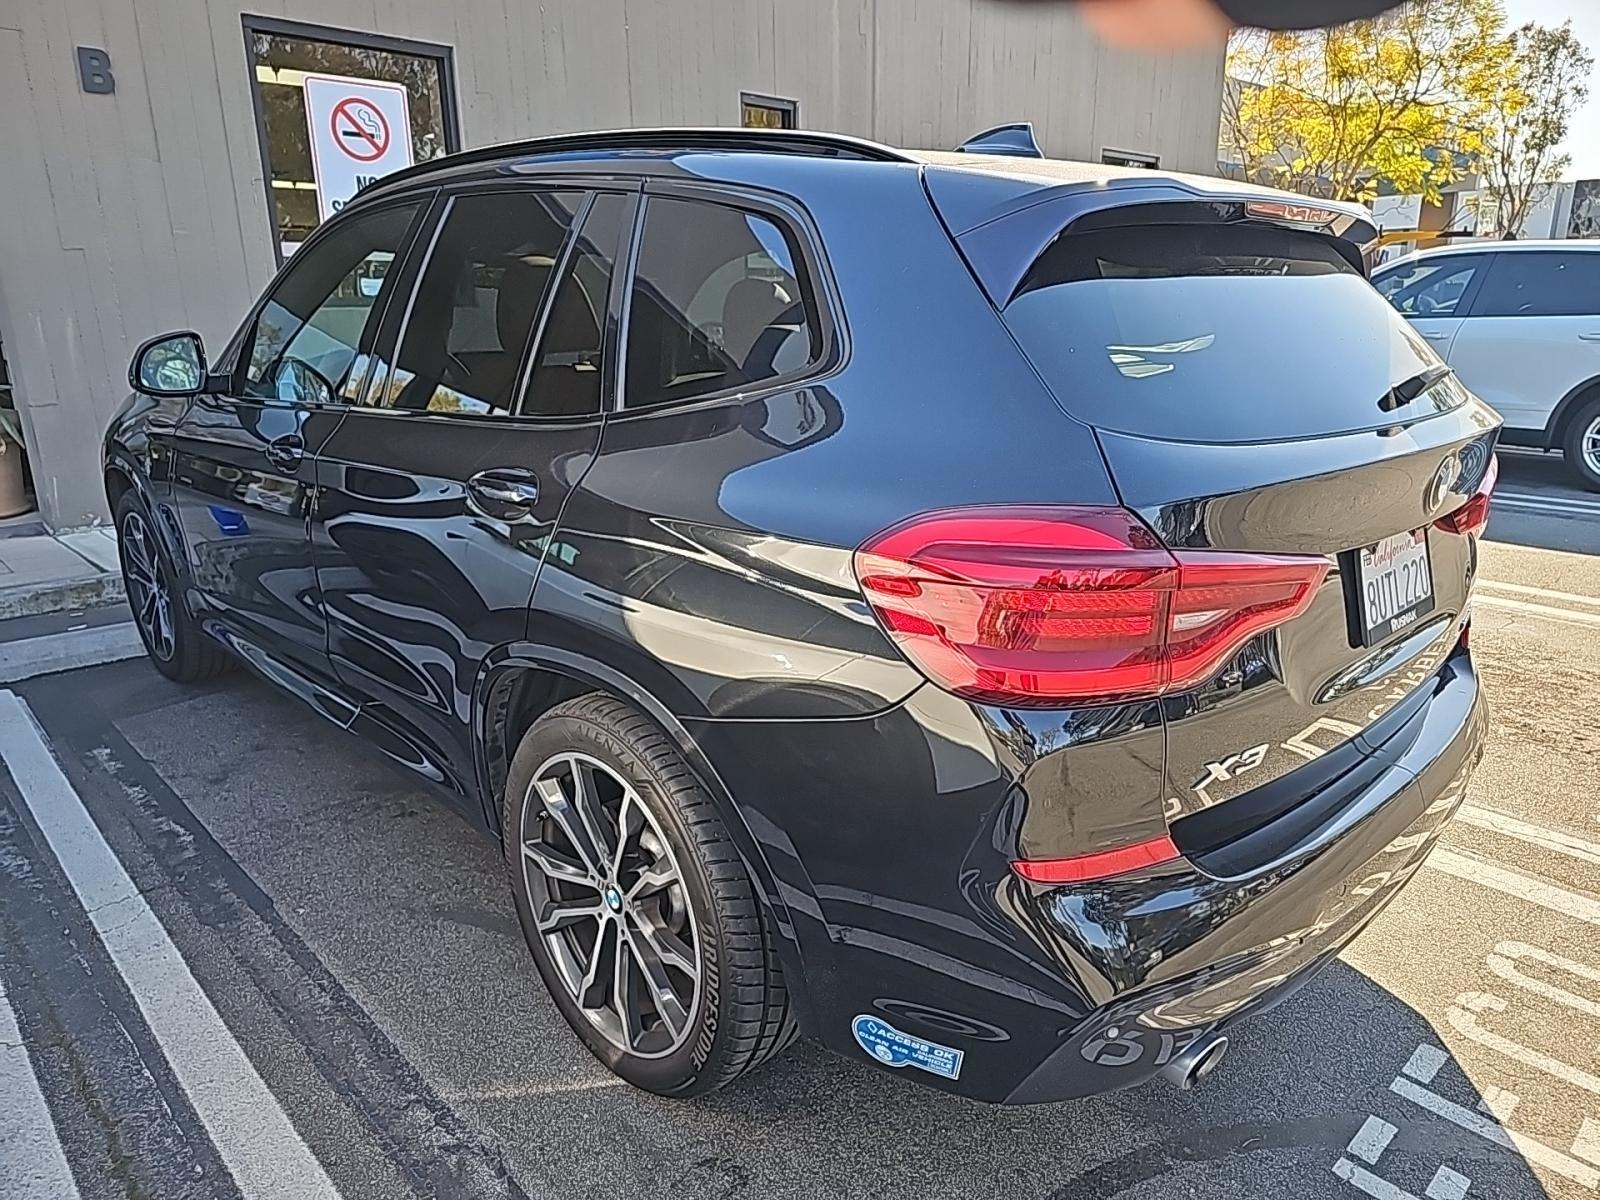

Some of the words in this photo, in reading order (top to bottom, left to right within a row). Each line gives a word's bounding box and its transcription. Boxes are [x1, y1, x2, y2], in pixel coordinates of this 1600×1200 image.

[76, 46, 115, 95] B
[1367, 554, 1429, 625] 8UTL220
[575, 724, 636, 774] ALENZA
[1190, 743, 1270, 791] X3
[689, 921, 720, 1071] BRIDGESTONE
[858, 1030, 890, 1047] CLEAN
[891, 1045, 909, 1056] AIR
[911, 1051, 954, 1069] VEHICLE
[877, 1028, 929, 1053] ACCESS
[933, 1048, 955, 1059] OK
